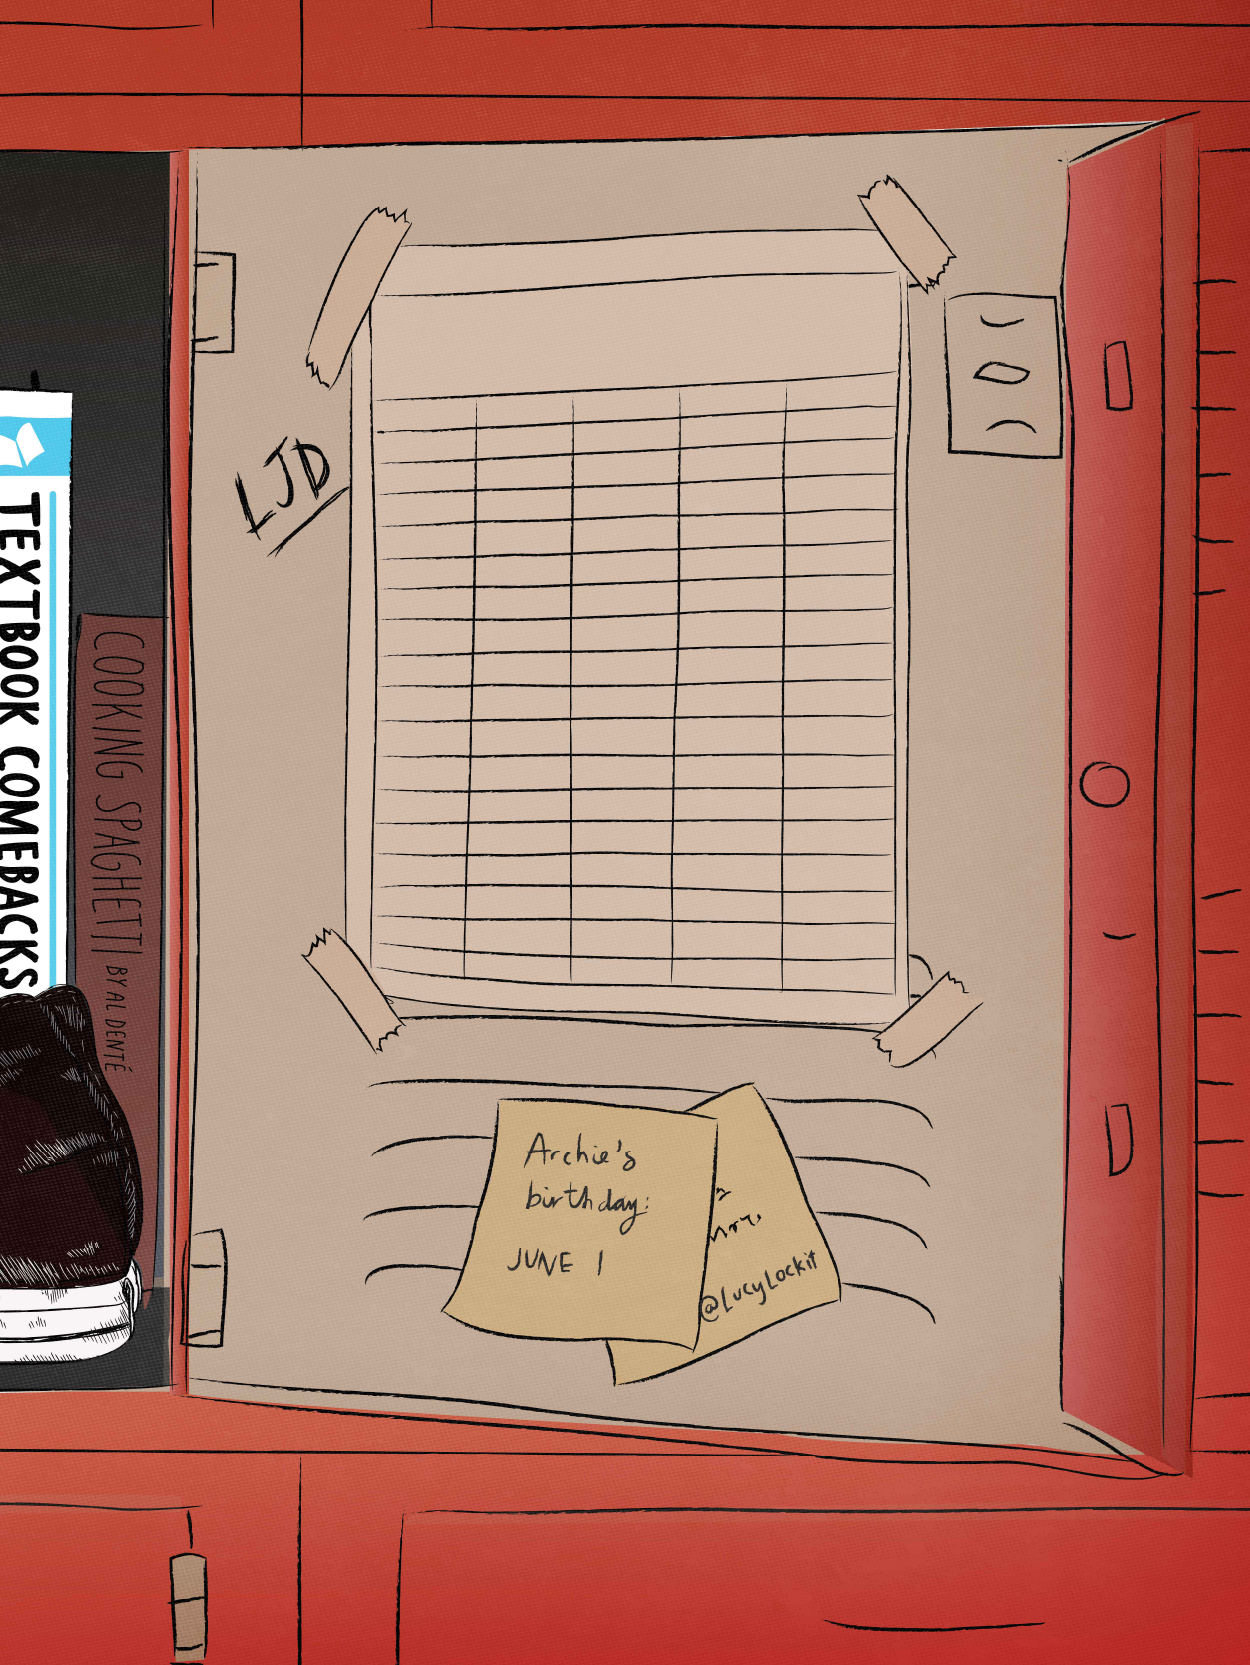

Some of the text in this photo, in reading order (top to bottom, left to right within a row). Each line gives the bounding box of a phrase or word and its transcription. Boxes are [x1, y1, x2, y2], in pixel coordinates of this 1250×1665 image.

[234, 435, 330, 541] LJD
[91, 630, 145, 780] COOKING
[89, 794, 144, 955] SPAGHETTI
[104, 964, 129, 988] BY
[104, 991, 128, 1012] AL
[523, 1131, 637, 1172] Archie's
[507, 1246, 574, 1277] JUNE
